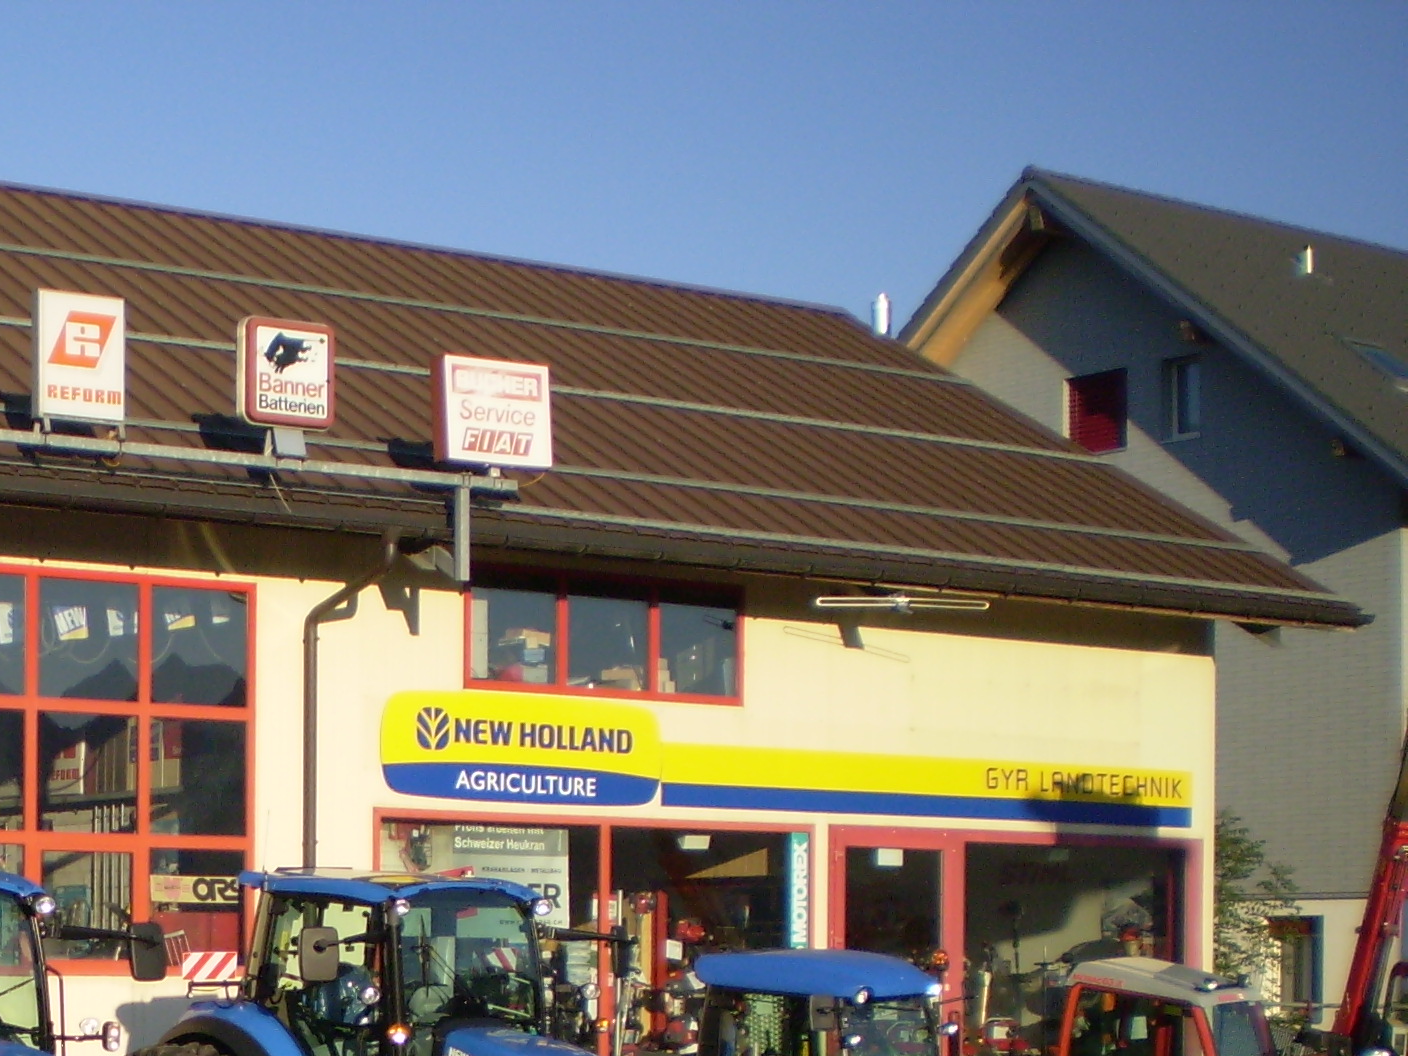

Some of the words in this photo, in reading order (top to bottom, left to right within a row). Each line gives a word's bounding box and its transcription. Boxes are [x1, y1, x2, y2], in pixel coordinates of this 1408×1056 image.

[47, 384, 122, 405] REFORM
[259, 372, 325, 398] Banner
[259, 393, 325, 415] Batterien
[460, 399, 536, 426] Service
[462, 427, 533, 457] FIAT
[54, 606, 87, 636] NEW
[454, 718, 513, 747] NEW
[519, 722, 633, 755] HOLLAND
[455, 770, 597, 797] AGRICULTURE
[986, 767, 1029, 791] GYR
[1040, 770, 1182, 799] LANDTECHNIK
[454, 836, 505, 849] Schweizer
[506, 838, 545, 851] Heukran
[792, 841, 809, 943] MOTOREX
